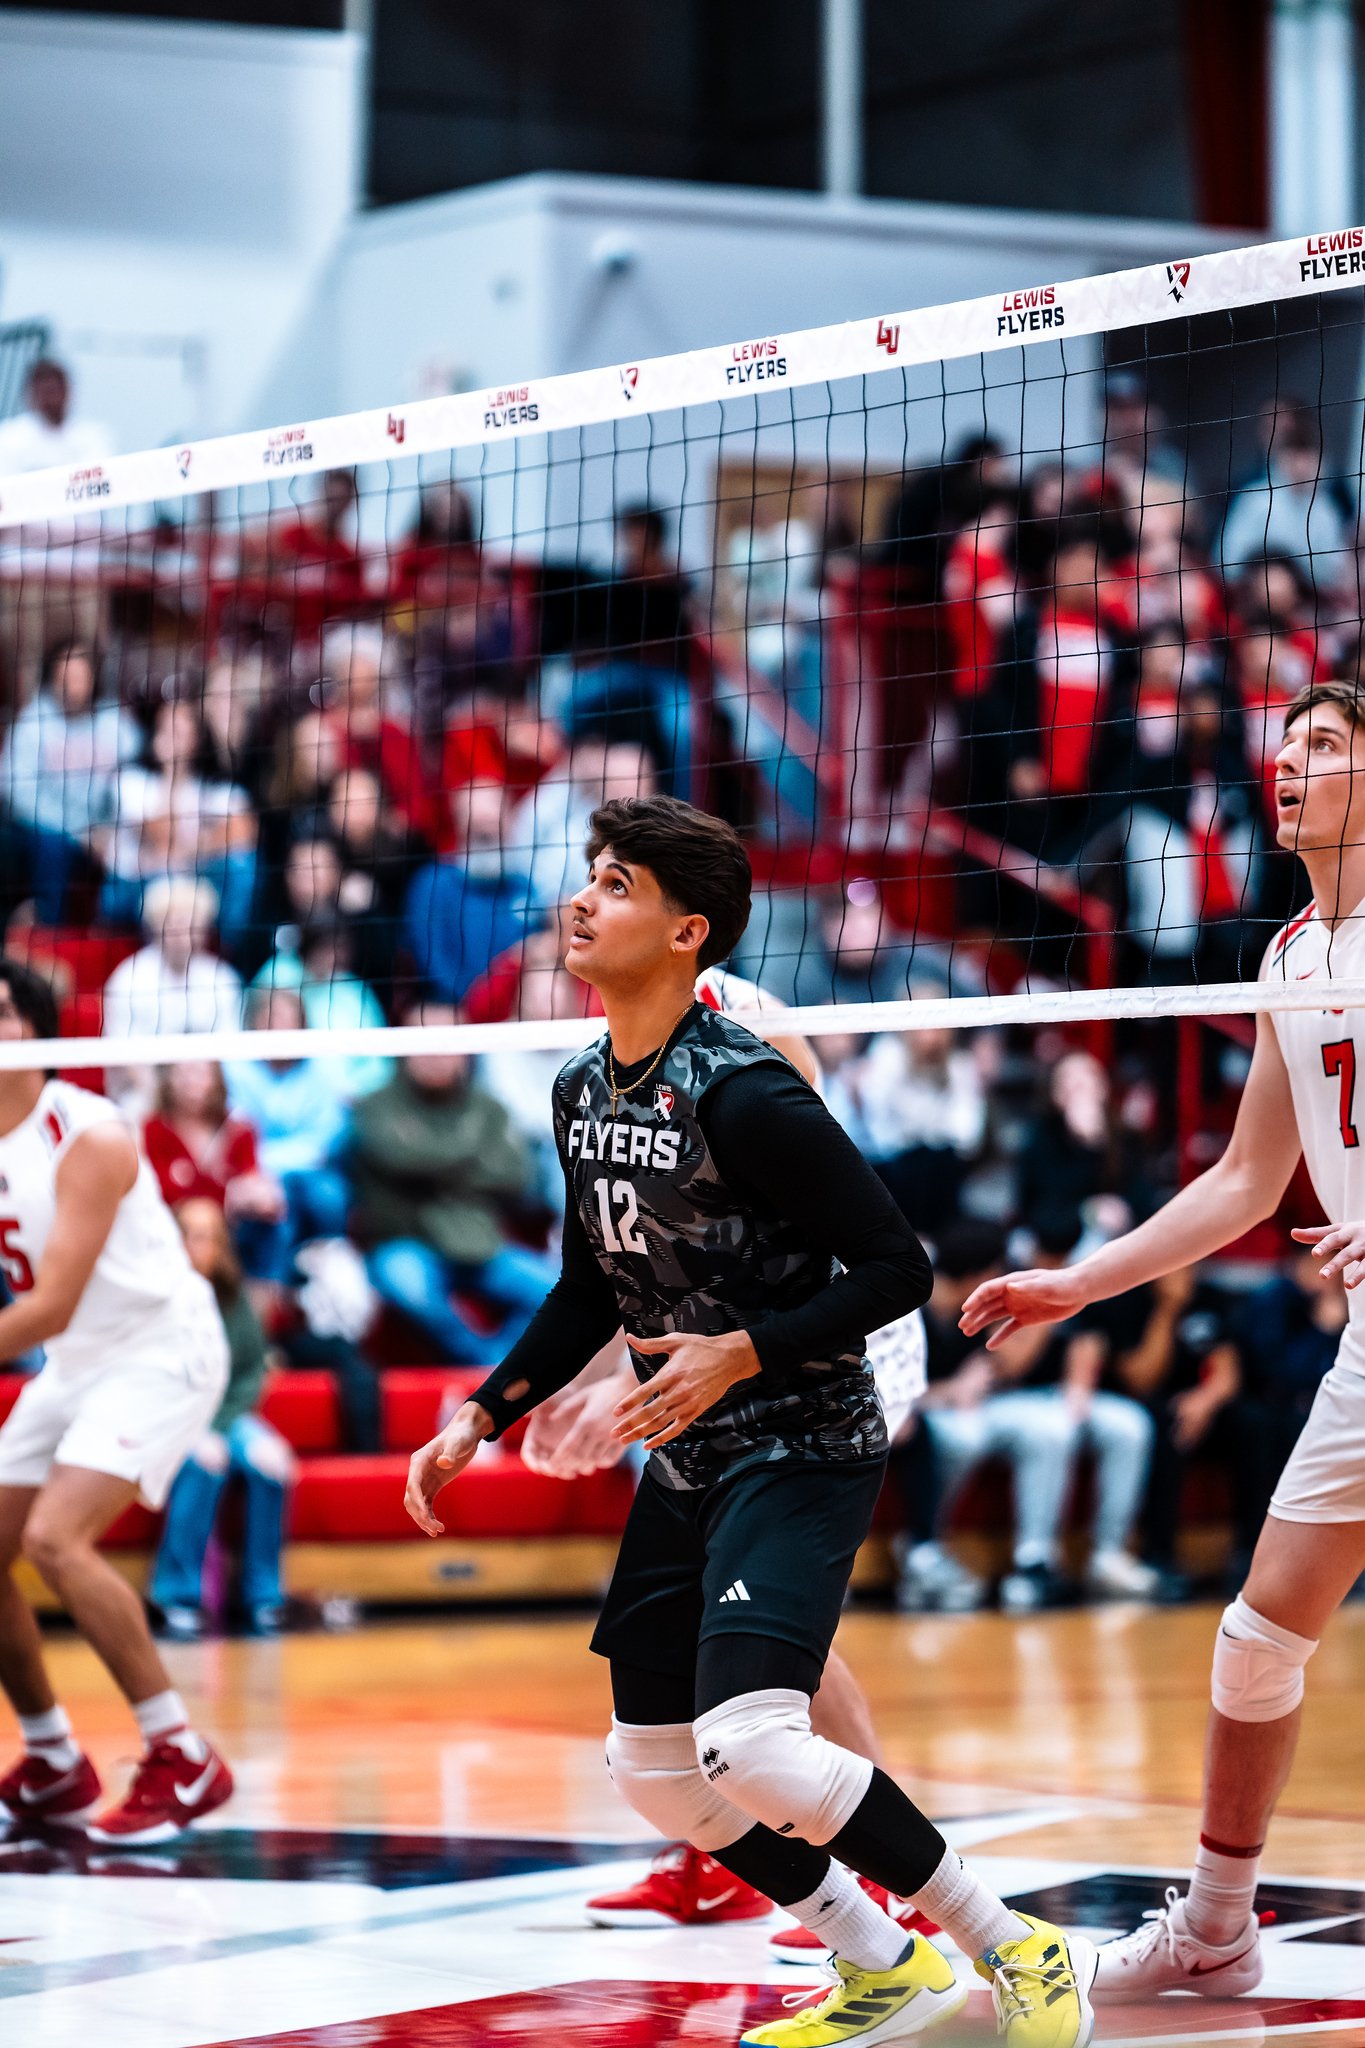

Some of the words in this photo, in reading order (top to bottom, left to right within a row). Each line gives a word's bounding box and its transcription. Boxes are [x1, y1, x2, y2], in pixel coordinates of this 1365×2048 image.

[1307, 228, 1364, 256] LEWIS
[1003, 286, 1055, 312] LEWIS
[997, 306, 1065, 336] FLYERS
[732, 339, 778, 362] LEWIS
[725, 357, 787, 385] FLYERS
[484, 404, 539, 429] FLYERS
[1321, 1037, 1360, 1149] 7
[568, 1119, 681, 1171] FLYERS
[593, 1177, 649, 1256] 12
